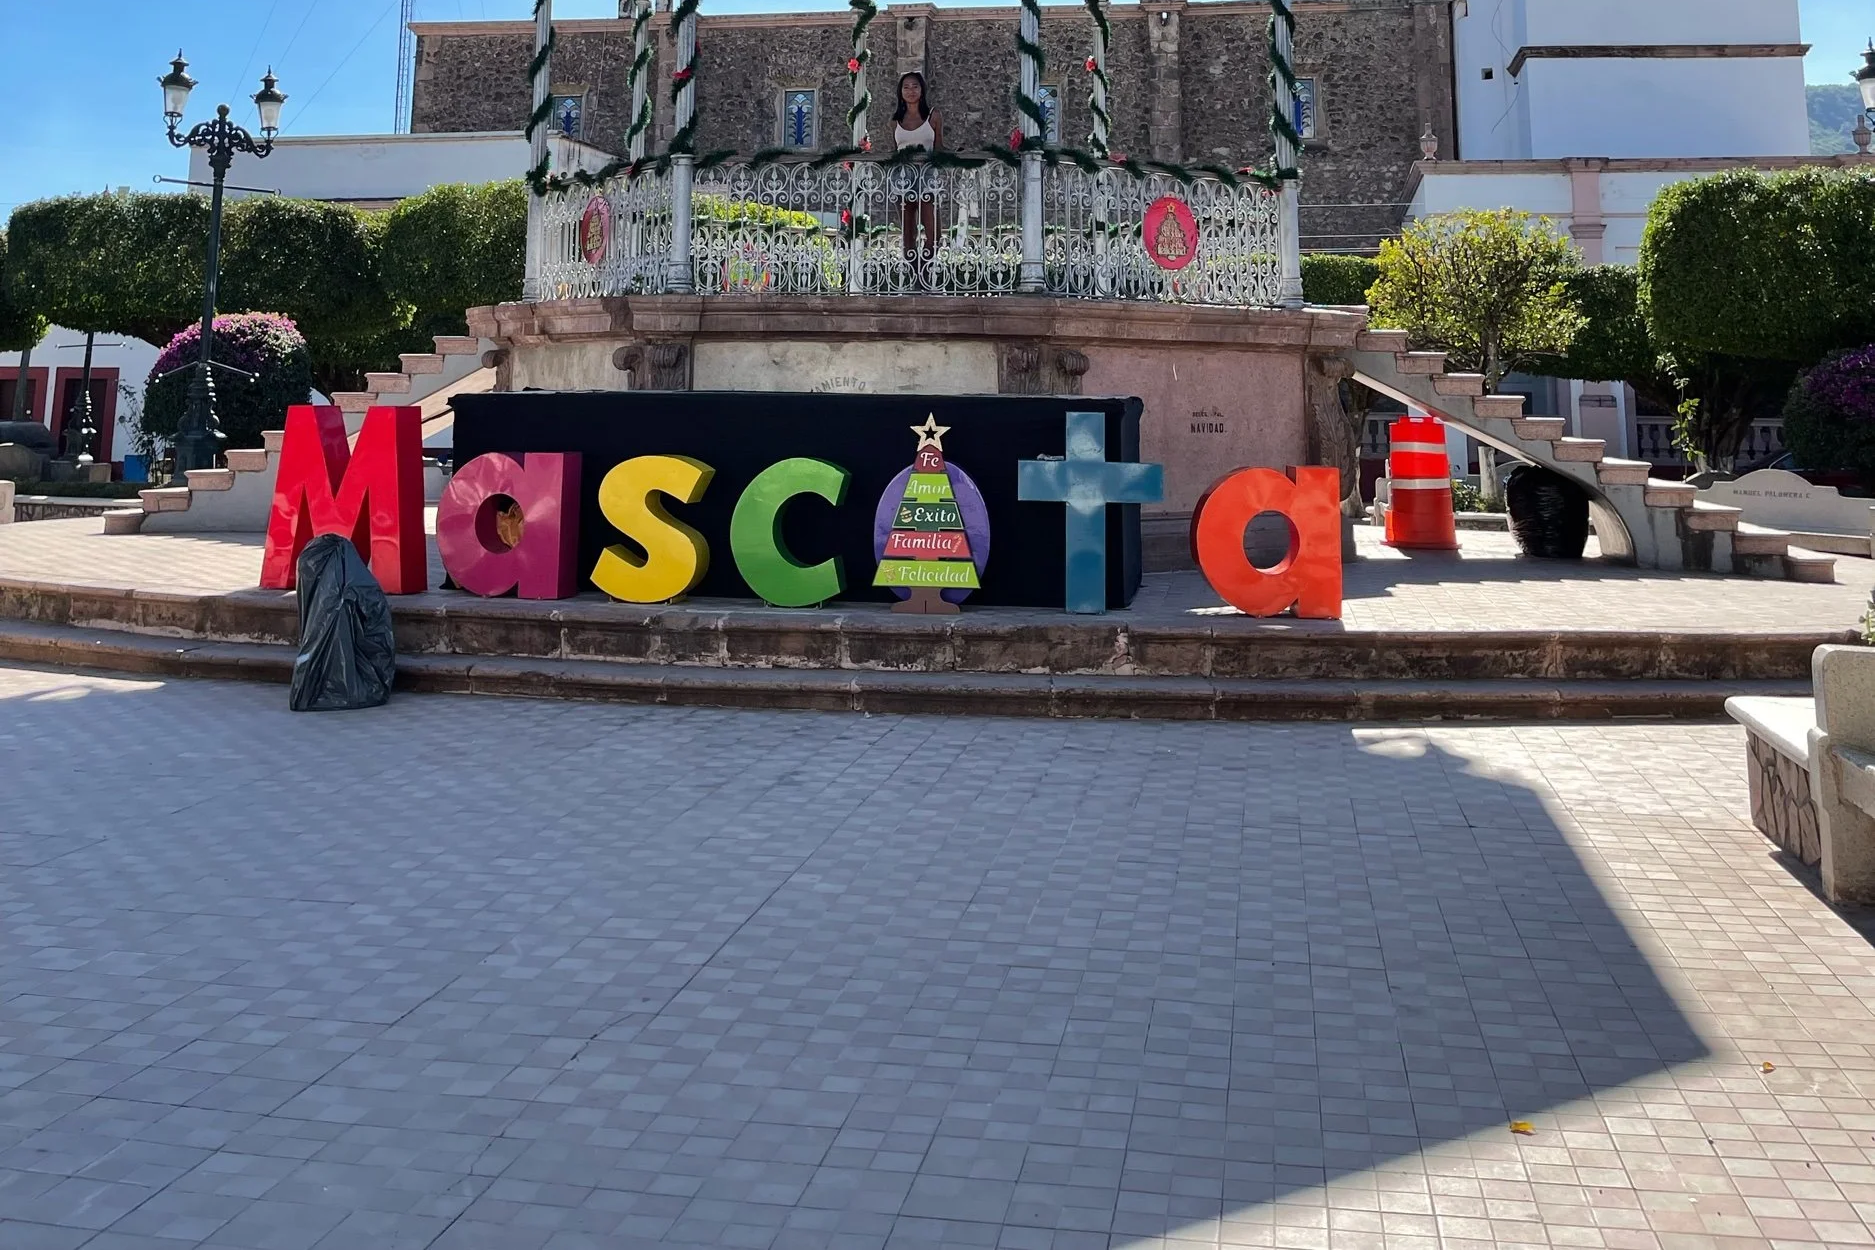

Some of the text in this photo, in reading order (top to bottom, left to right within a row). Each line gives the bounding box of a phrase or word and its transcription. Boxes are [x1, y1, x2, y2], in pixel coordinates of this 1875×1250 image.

[920, 452, 940, 467] Fe
[907, 480, 950, 495] Amor
[914, 507, 956, 522] Exito
[892, 533, 952, 550] Familia
[899, 565, 970, 583] Felicidad
